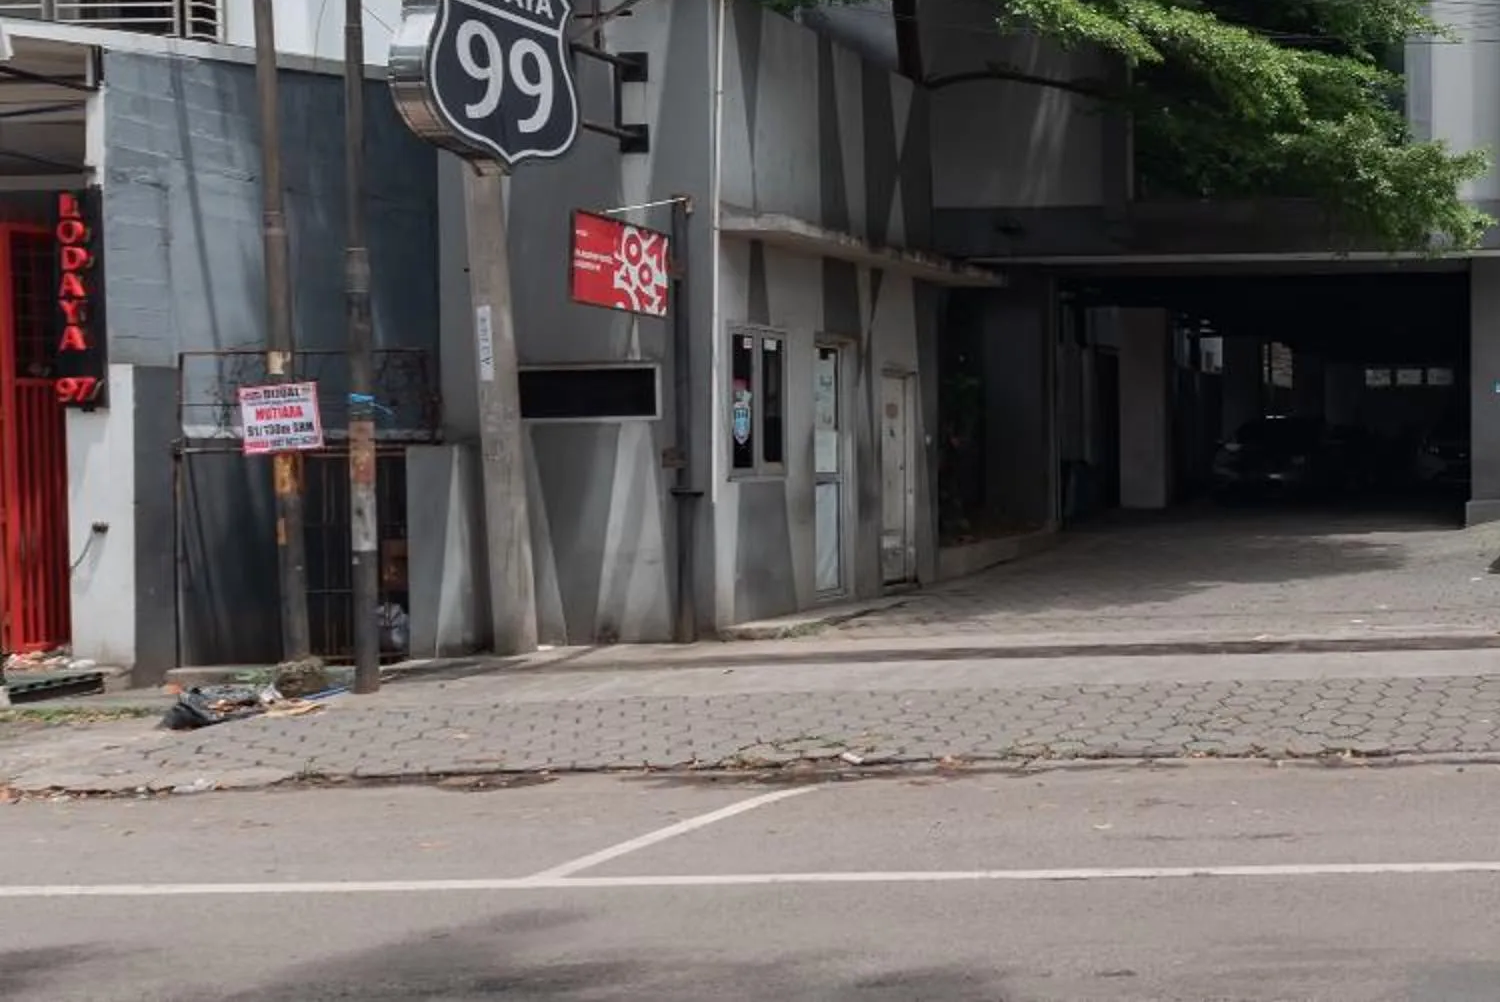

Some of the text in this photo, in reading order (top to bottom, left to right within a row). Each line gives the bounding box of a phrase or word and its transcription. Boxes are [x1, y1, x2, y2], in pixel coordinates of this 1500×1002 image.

[456, 19, 554, 133] 99
[56, 192, 88, 350] LODAYA
[55, 377, 96, 402] 97
